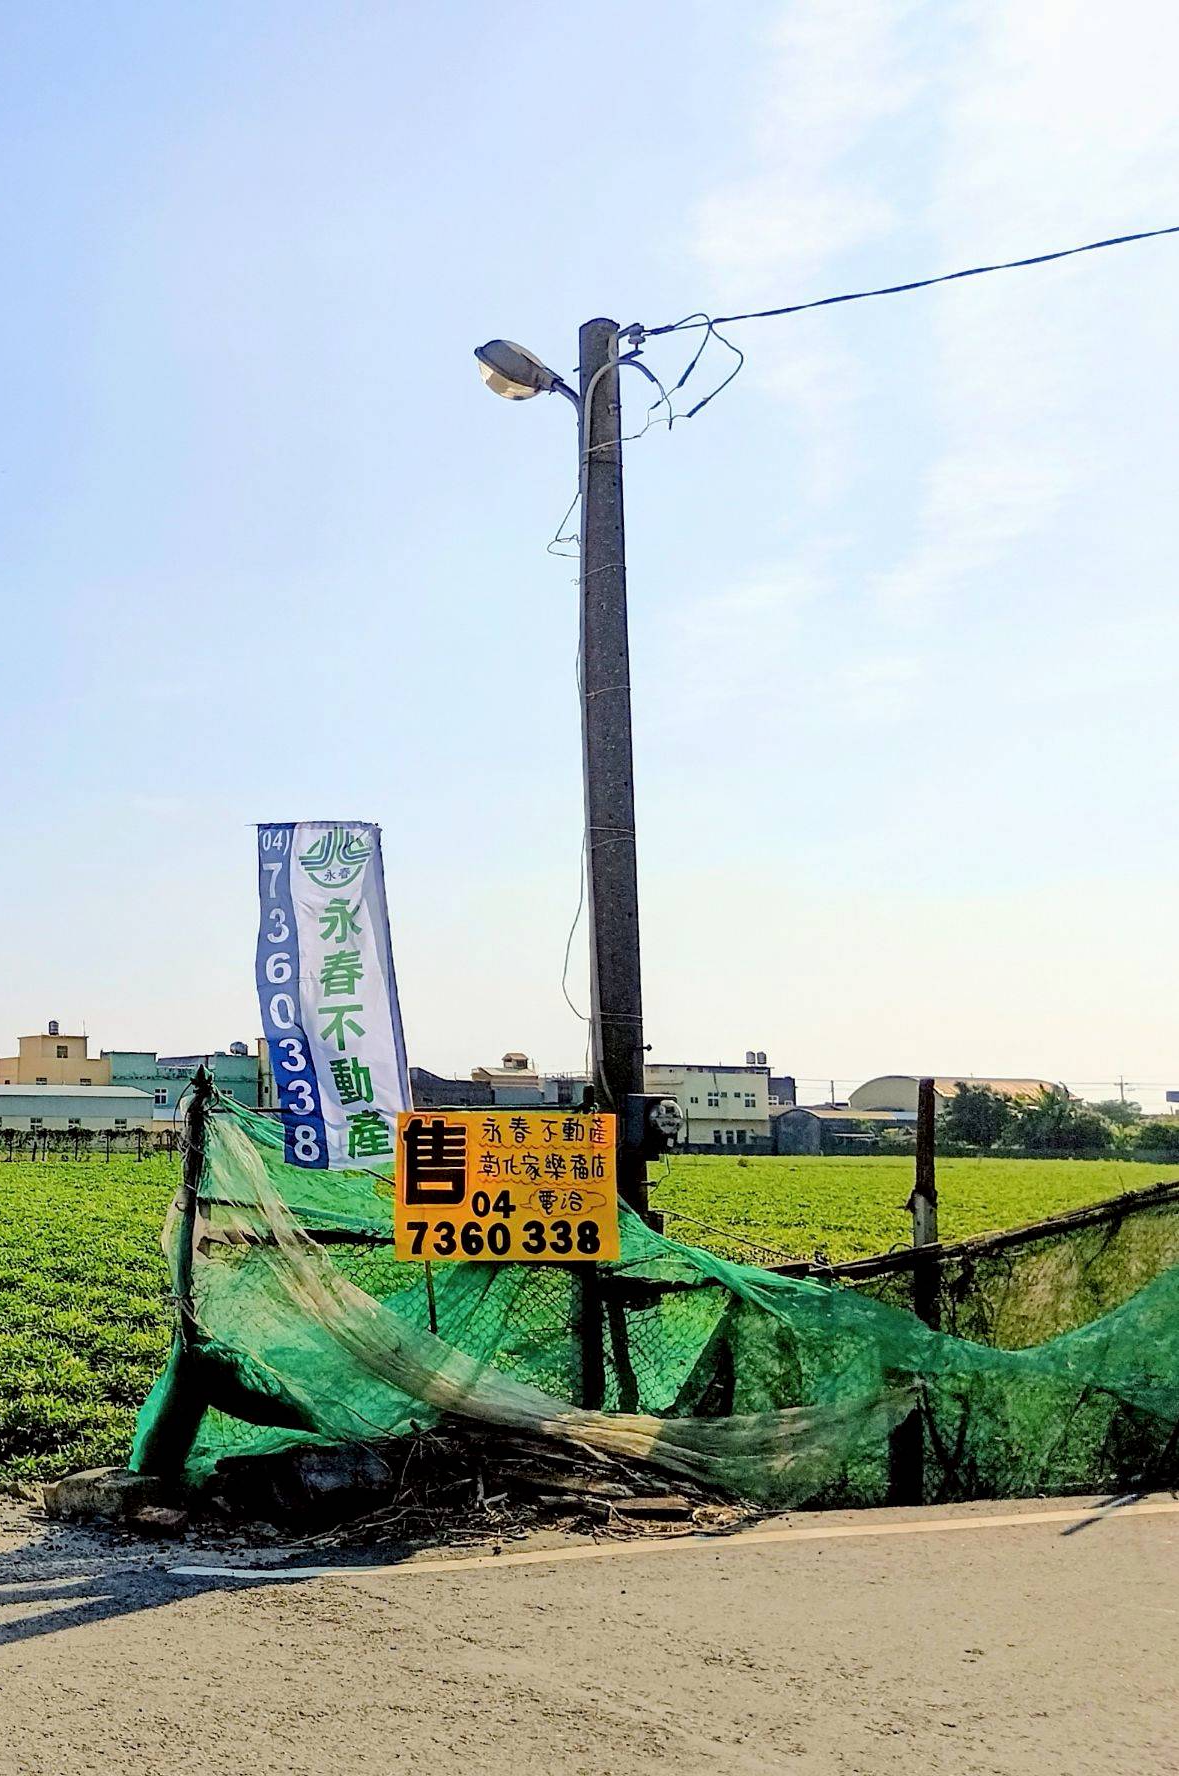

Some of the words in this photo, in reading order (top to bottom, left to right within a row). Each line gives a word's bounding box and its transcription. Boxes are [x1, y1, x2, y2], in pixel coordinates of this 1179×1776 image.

[323, 867, 352, 882] 永春
[262, 862, 321, 1162] 7360338
[318, 898, 394, 1159] 永春不動產
[482, 1116, 607, 1144] 永春不動產
[403, 1119, 466, 1204] 售
[477, 1151, 607, 1180] 彰化家樂福店
[471, 1190, 516, 1219] 04
[538, 1190, 583, 1215] 電洽
[406, 1221, 511, 1255] 7360
[522, 1220, 601, 1254] 338
